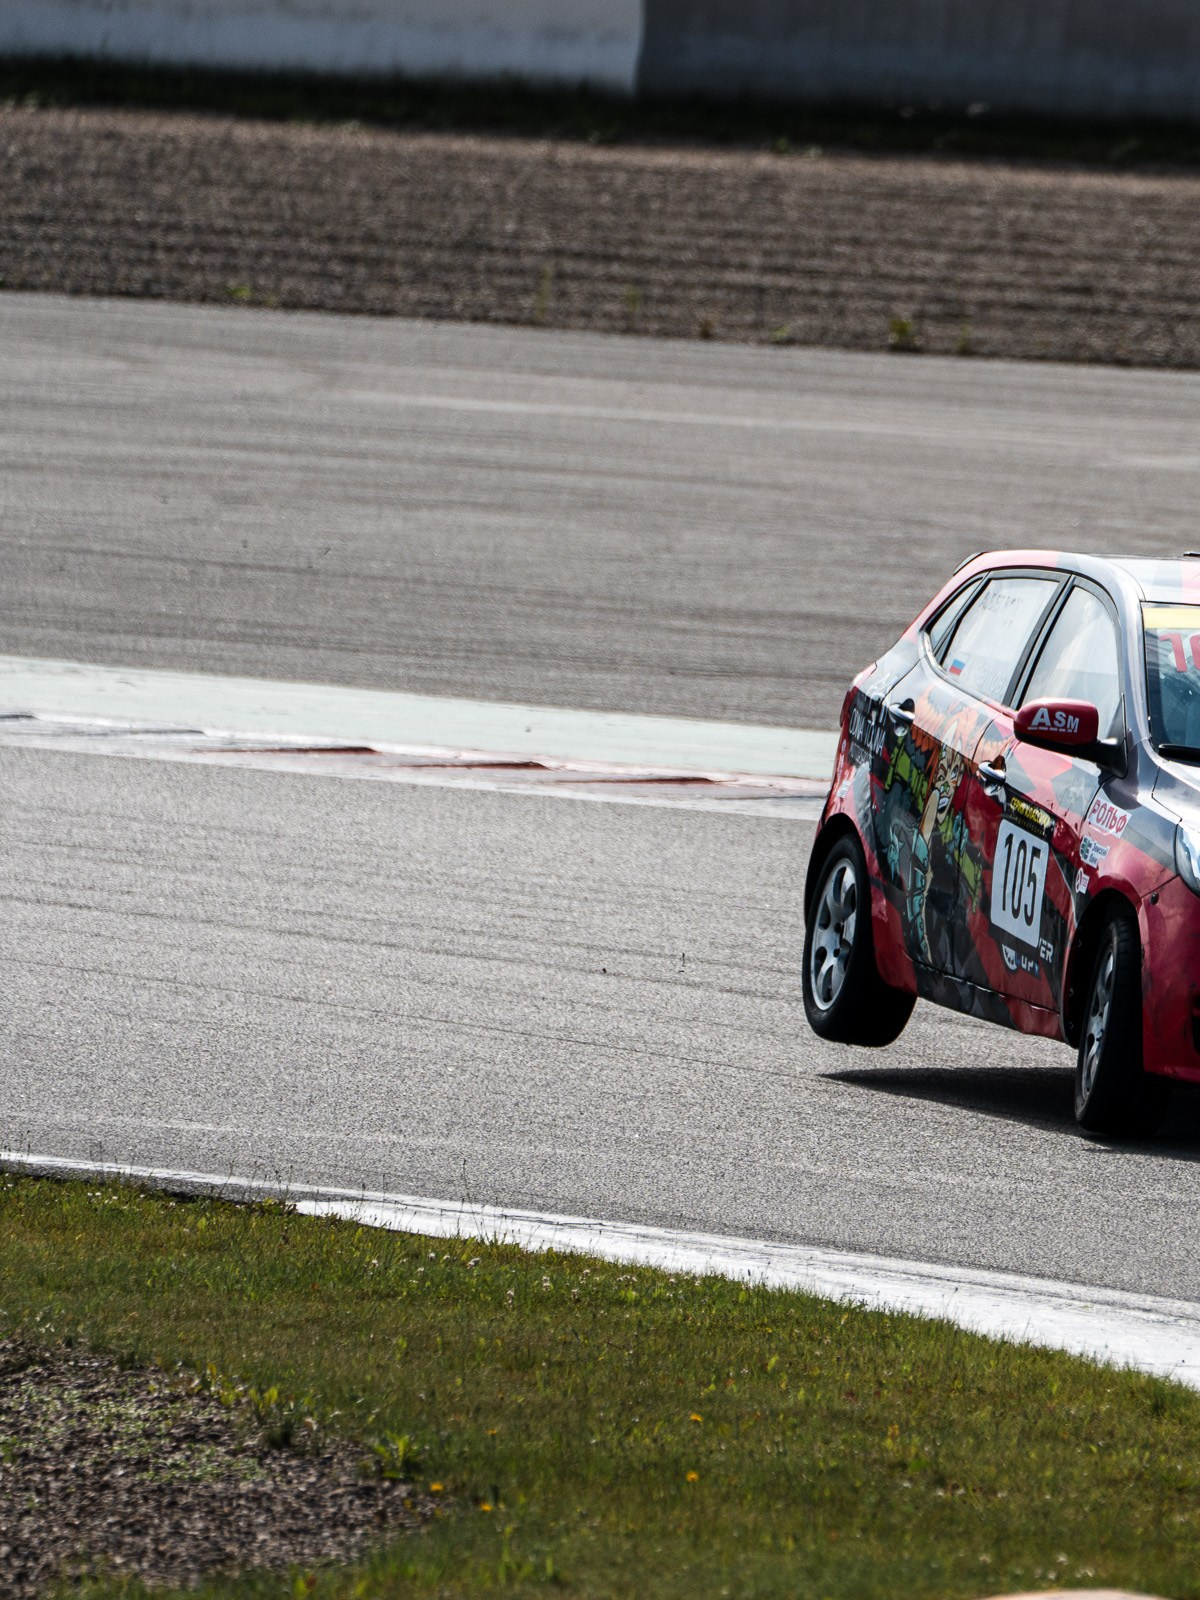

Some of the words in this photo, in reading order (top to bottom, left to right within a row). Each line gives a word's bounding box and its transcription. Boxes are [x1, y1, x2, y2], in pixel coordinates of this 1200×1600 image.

[1031, 707, 1080, 733] ASM
[1088, 799, 1128, 833] РОЛЬФ
[1002, 833, 1041, 926] 105
